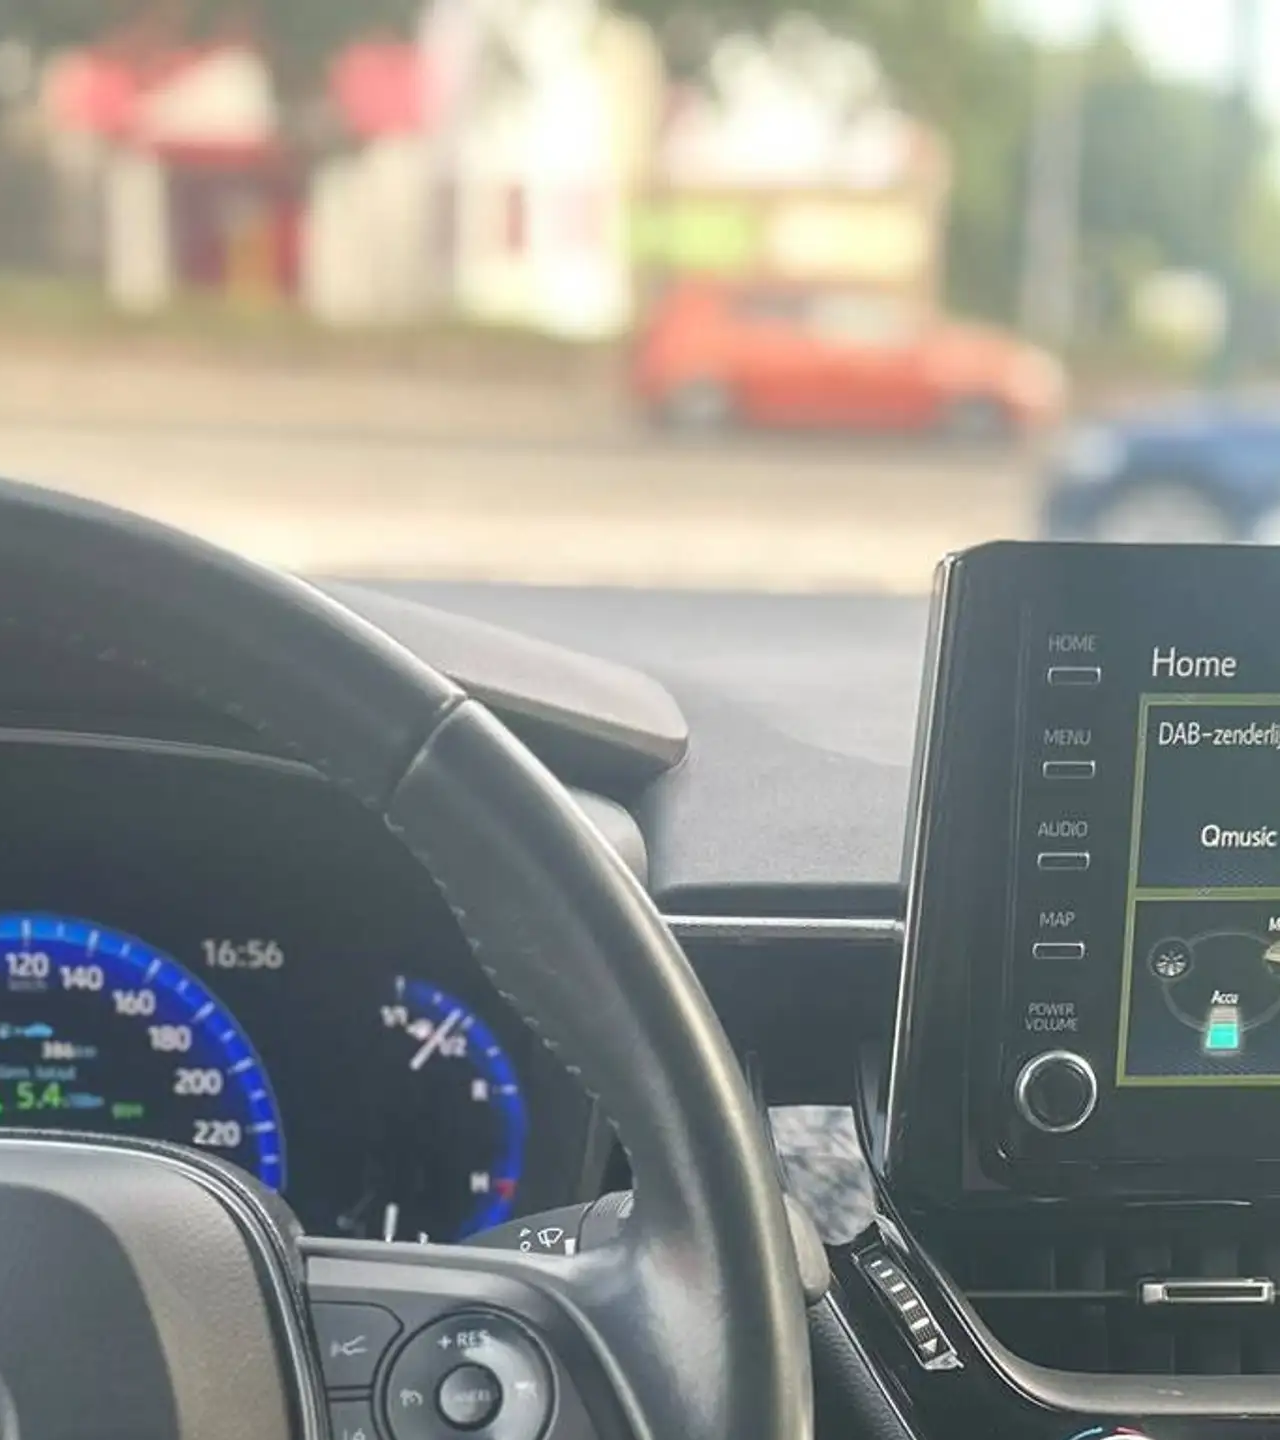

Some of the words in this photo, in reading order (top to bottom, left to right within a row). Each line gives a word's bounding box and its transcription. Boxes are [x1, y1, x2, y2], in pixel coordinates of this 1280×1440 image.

[1048, 635, 1097, 653] HOME
[1151, 646, 1238, 678] Home
[1043, 728, 1092, 747] MENU
[1037, 821, 1089, 839] AUDIO
[1201, 824, 1278, 850] Qmusic
[1039, 910, 1075, 928] MAP
[5, 951, 50, 979] 120
[201, 939, 284, 969] 16:56
[59, 965, 104, 991] 140
[112, 989, 156, 1016] 160
[146, 1024, 193, 1052] 180
[173, 1068, 225, 1095] 200
[192, 1120, 243, 1147] 220
